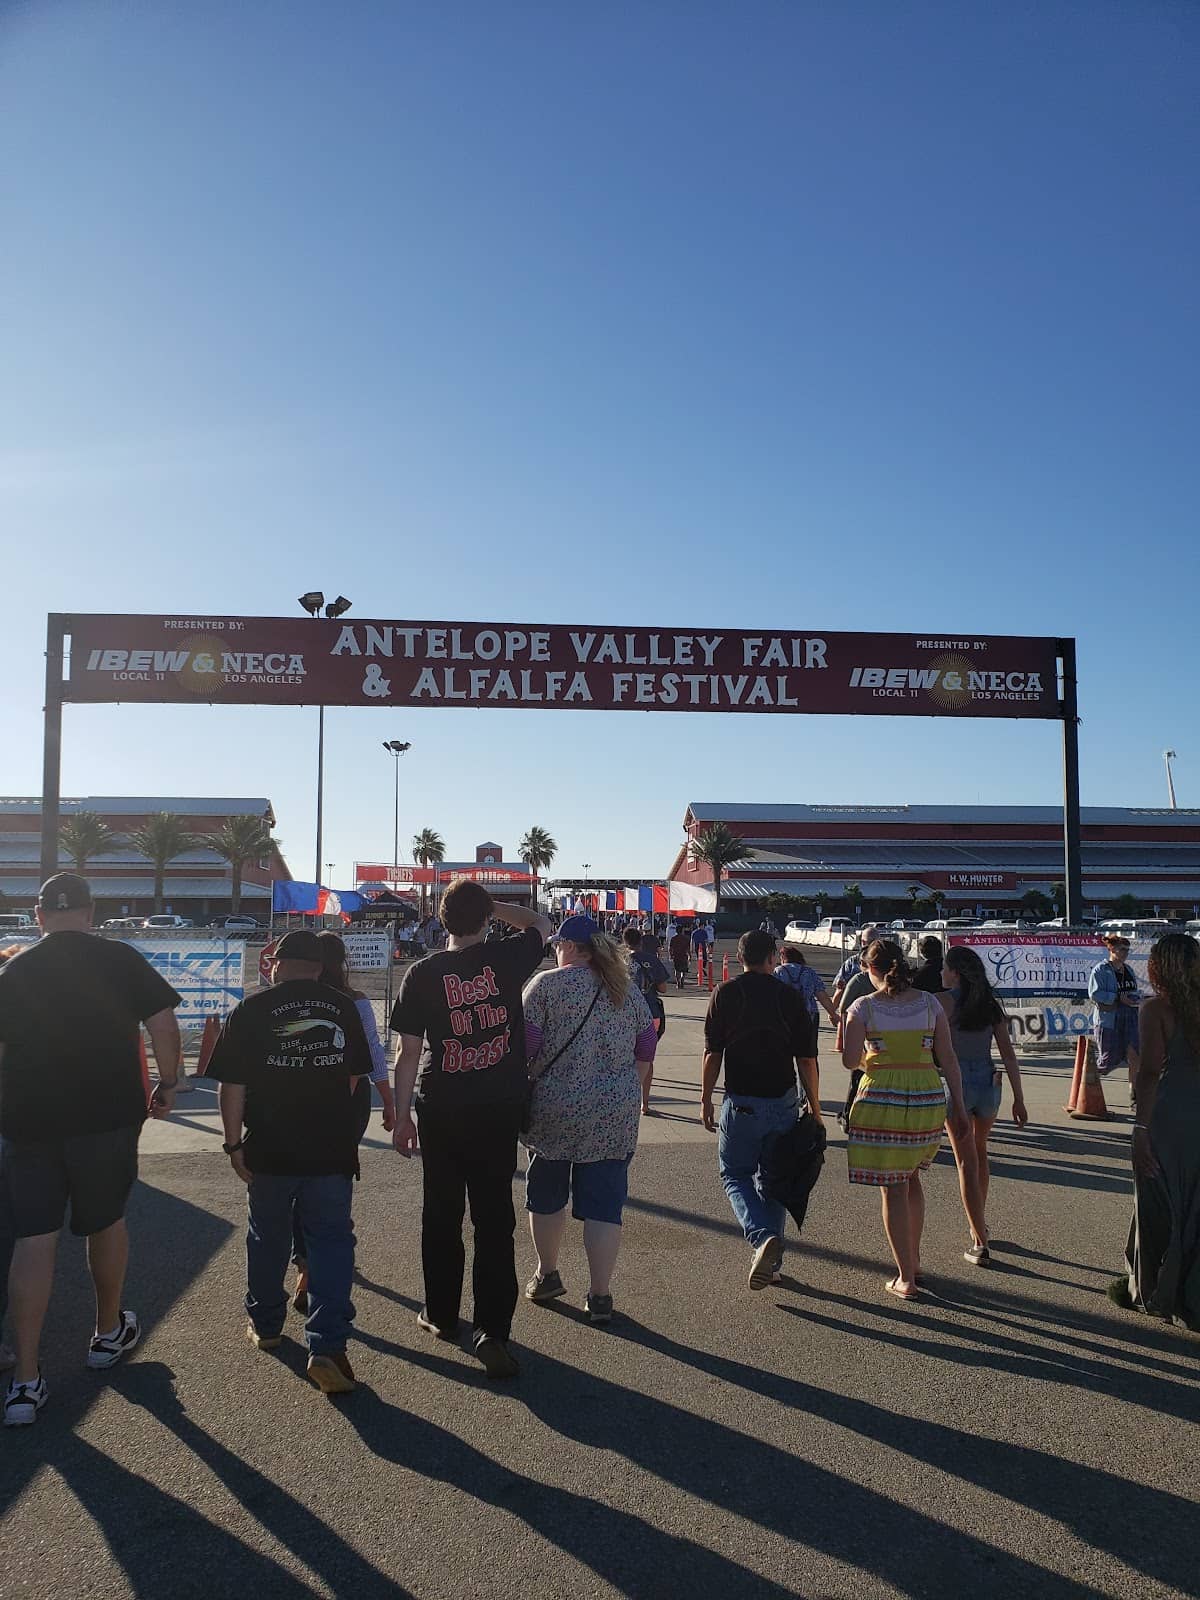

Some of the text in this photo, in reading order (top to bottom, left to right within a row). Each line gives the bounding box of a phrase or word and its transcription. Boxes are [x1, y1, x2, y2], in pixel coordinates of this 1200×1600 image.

[164, 620, 245, 631] PRESENTED BY:
[330, 625, 829, 668] ANTELOPE VALLEY FAIR
[916, 640, 988, 650] PRESENTED BY:
[86, 649, 307, 675] IBEW & NECA
[113, 672, 165, 681] LOCAL 11
[224, 674, 302, 684] LOS ANGELES
[849, 667, 1044, 692] IBEW & NECA
[362, 663, 799, 706] & ALFALFA FESTIVAL
[872, 688, 918, 698] LOCAL 11
[971, 691, 1040, 701] LOS ANGELES
[386, 867, 414, 882] TICKETS
[450, 870, 511, 881] Box Office
[970, 874, 1004, 883] HUNTER
[974, 936, 1090, 945] ANTELOPE VALLEY HOSPITAL
[987, 946, 1093, 982] Commun
[1025, 952, 1062, 968] Caring
[443, 966, 500, 1009] Best
[271, 1000, 303, 1017] THRILL
[450, 1003, 508, 1036] Of The
[297, 1040, 329, 1053] TAKERS
[442, 1025, 511, 1073] Beast
[266, 1052, 345, 1068] SALTY CREW
